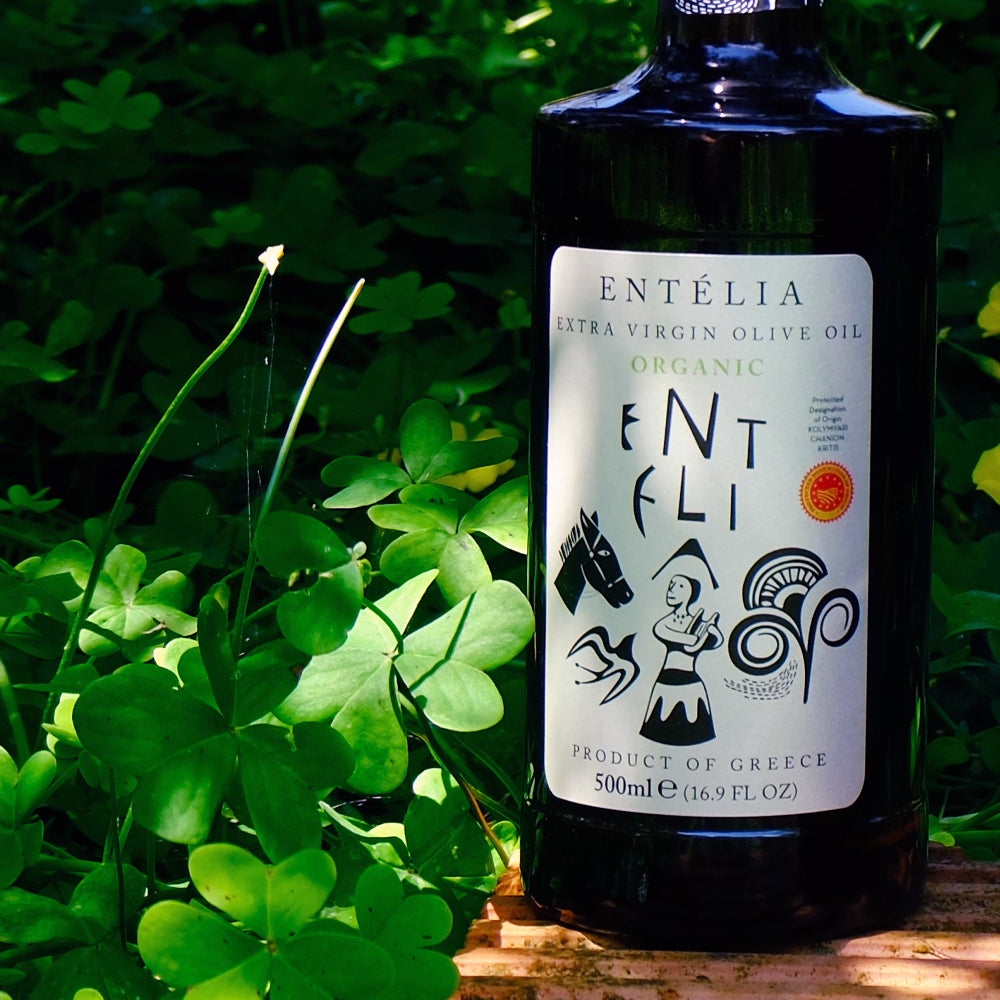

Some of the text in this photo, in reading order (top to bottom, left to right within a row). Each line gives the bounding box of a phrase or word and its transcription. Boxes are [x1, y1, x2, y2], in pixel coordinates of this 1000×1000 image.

[599, 273, 803, 306] ENTÉLIA
[556, 316, 863, 342] EXTRA VIRGIN OLIVE OIL
[630, 355, 765, 377] ORGANIC
[572, 743, 828, 772] PRODUCT OF GREECE
[594, 772, 652, 798] 500ml
[683, 784, 726, 803] (16.9
[731, 785, 757, 801] FL
[761, 781, 799, 802] OZ)
